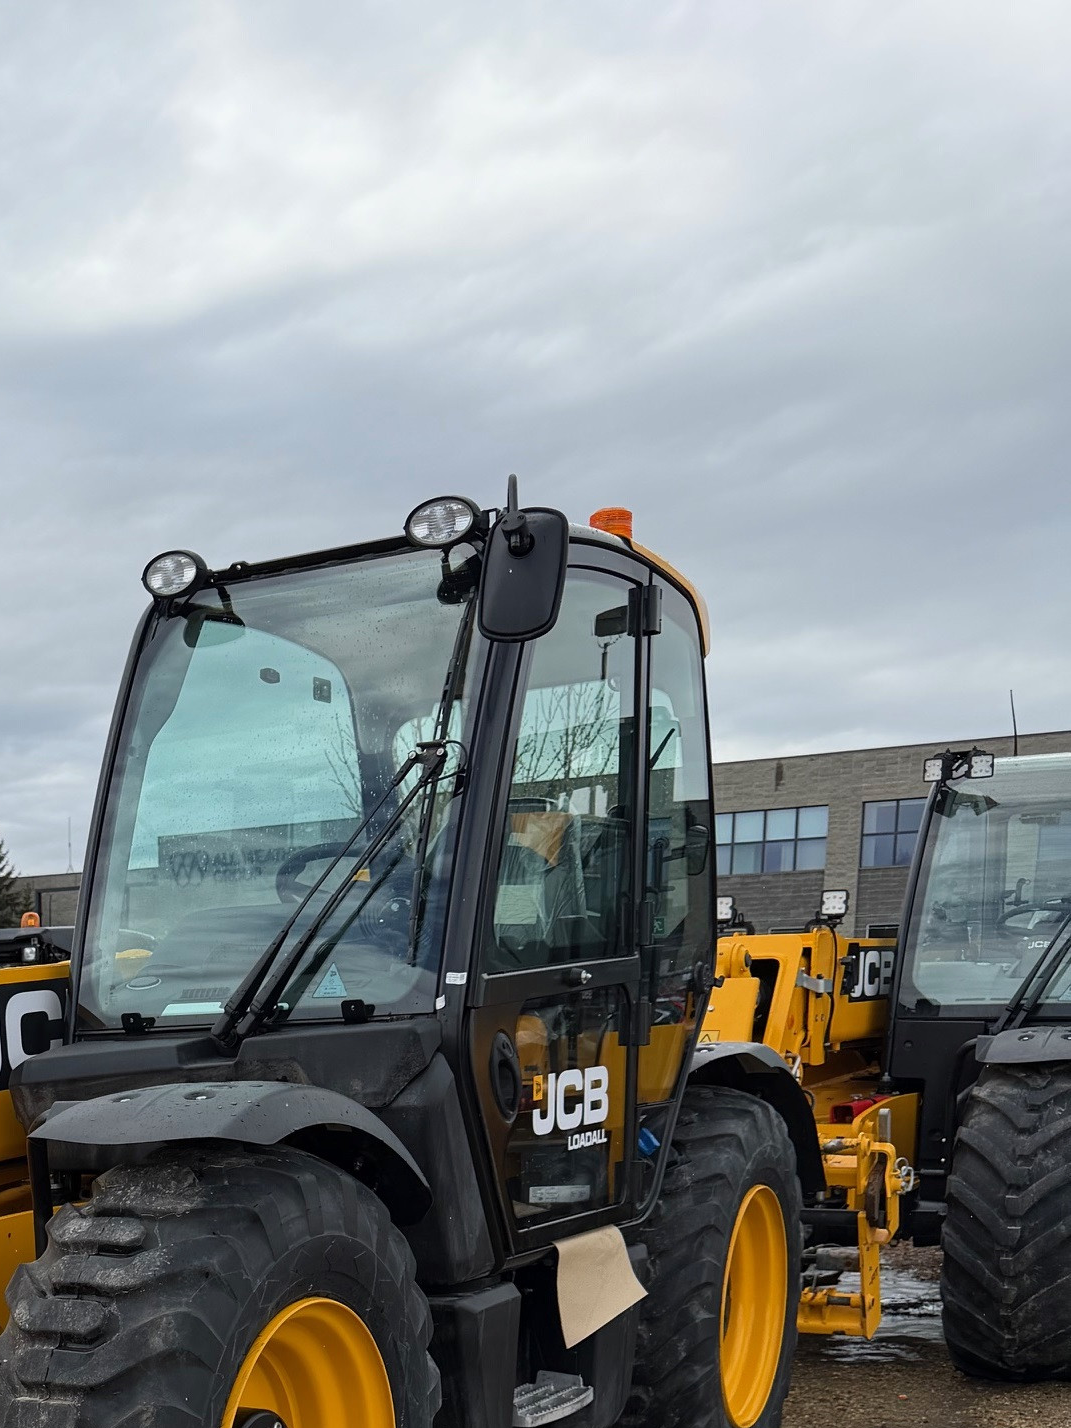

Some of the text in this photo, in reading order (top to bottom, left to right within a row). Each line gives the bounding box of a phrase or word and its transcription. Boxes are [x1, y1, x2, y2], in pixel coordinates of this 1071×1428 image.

[850, 950, 895, 998] JCB
[532, 1065, 609, 1136] JCB
[567, 1128, 608, 1151] LOADALL
